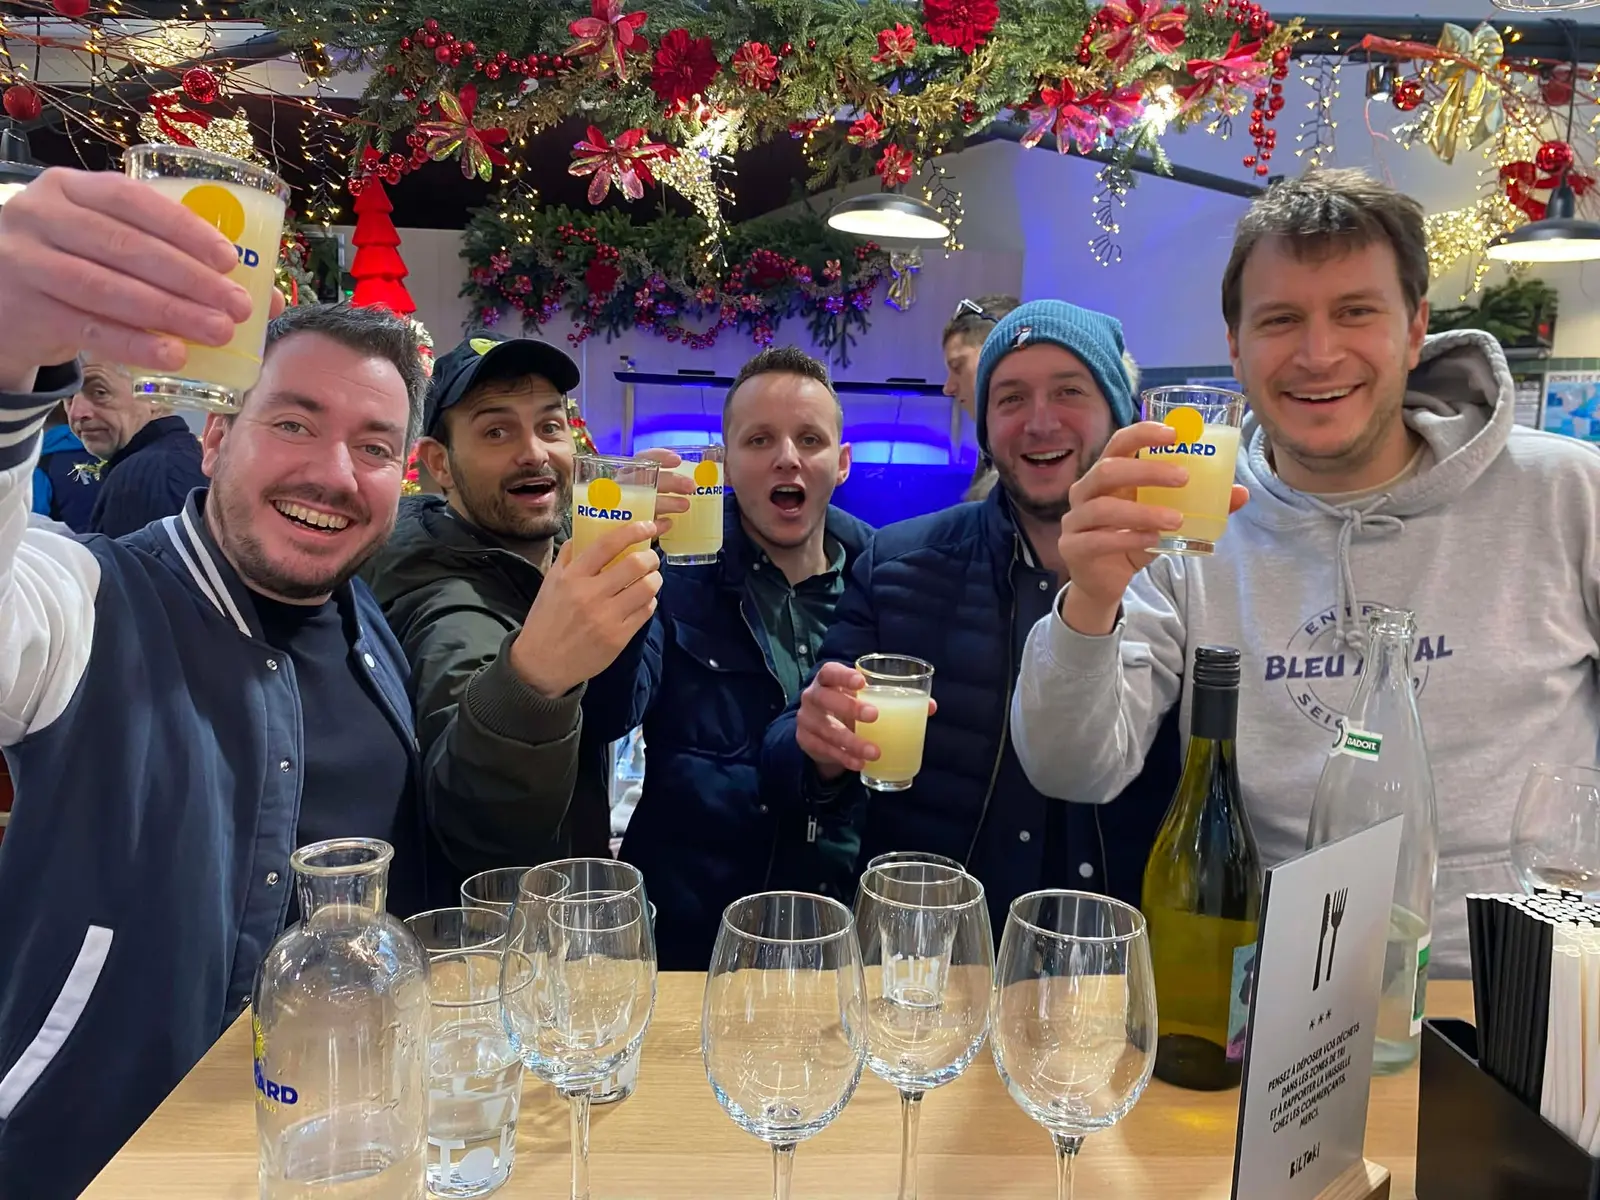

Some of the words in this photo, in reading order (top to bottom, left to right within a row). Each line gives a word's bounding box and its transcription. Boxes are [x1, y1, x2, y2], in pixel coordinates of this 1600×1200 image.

[1149, 442, 1216, 456] RICARD
[690, 485, 723, 496] CARD
[577, 504, 633, 521] RICARD
[1265, 654, 1345, 681] BLEU
[1267, 1067, 1291, 1093] PENSEZ
[1296, 1046, 1323, 1074] DÉPOSER
[1323, 1037, 1336, 1055] VOS
[1281, 1077, 1299, 1098] DANS
[1298, 1070, 1309, 1087] LES
[1309, 1056, 1329, 1079] ZONES
[1329, 1051, 1337, 1065] DE
[1336, 1044, 1346, 1059] TRI
[1269, 1107, 1278, 1121] ET
[1283, 1080, 1317, 1112] RAPPORTER
[1272, 1112, 1290, 1133] CHEZ
[1289, 1105, 1300, 1122] LES
